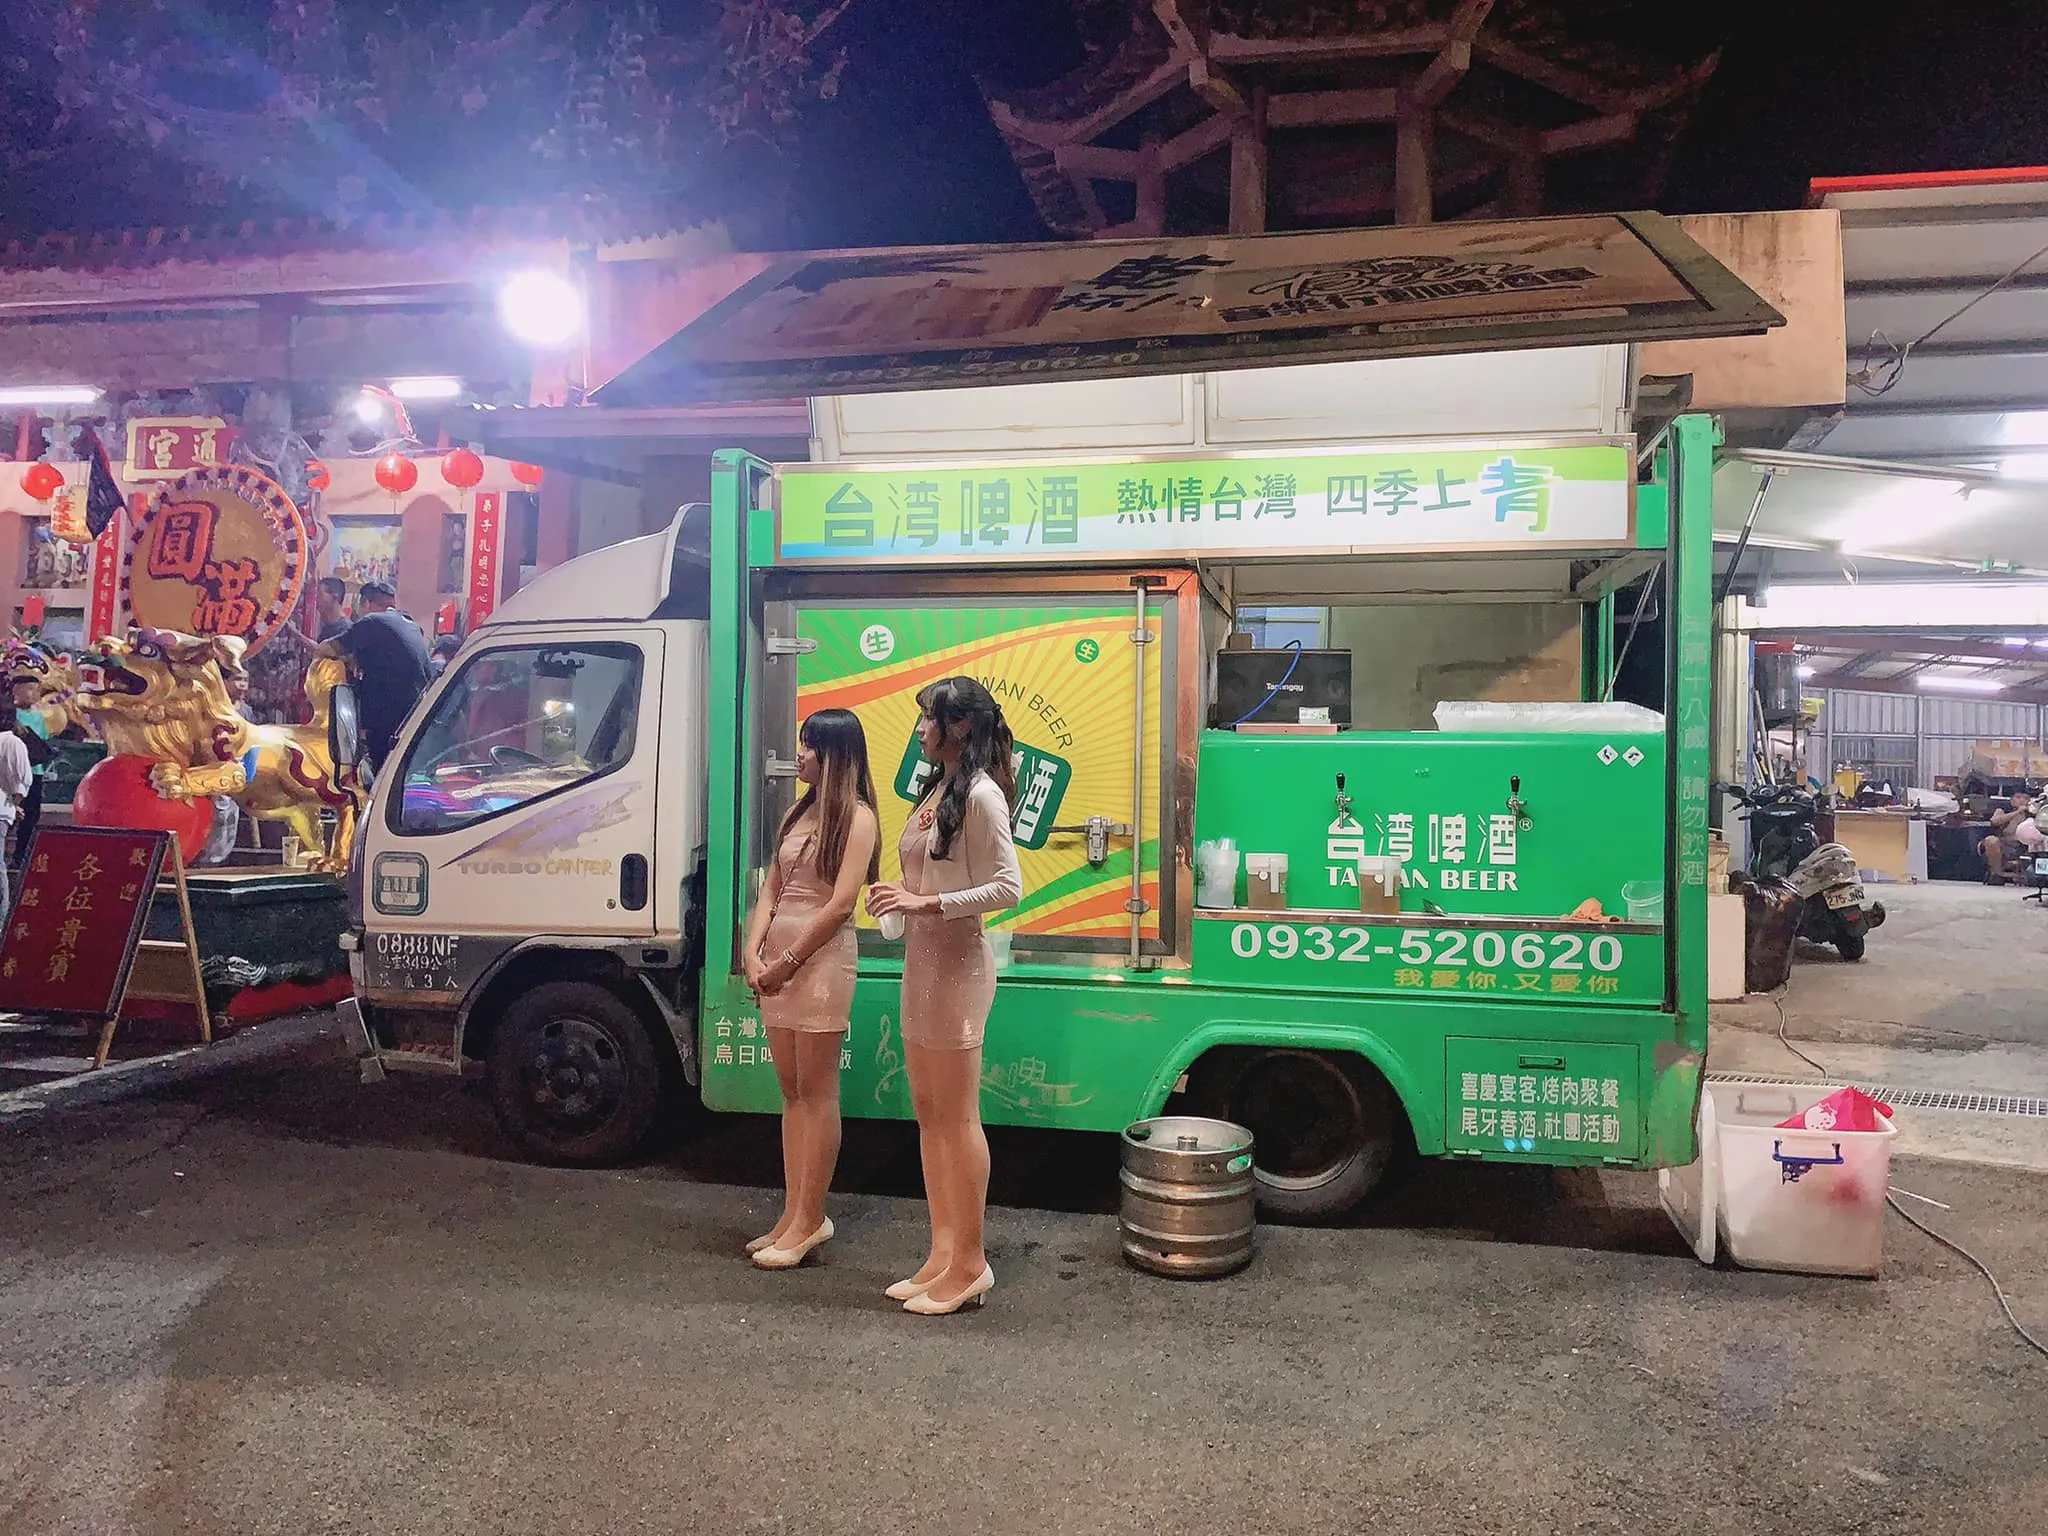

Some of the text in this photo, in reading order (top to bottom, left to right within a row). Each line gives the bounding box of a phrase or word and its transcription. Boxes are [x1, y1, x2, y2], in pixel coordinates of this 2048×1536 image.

[824, 457, 1554, 548] 台湾啤酒 熱情台灣 四季上青
[866, 630, 890, 656] 生
[1076, 640, 1099, 662] 生
[976, 676, 1073, 750] WAN BEER
[1327, 812, 1517, 865] 台湾啤酒
[458, 858, 613, 877] TURBO CANTER
[1325, 866, 1519, 892] TAAN BEER
[45, 853, 104, 983] 各位貴賓
[1230, 924, 1623, 971] 0932-520620
